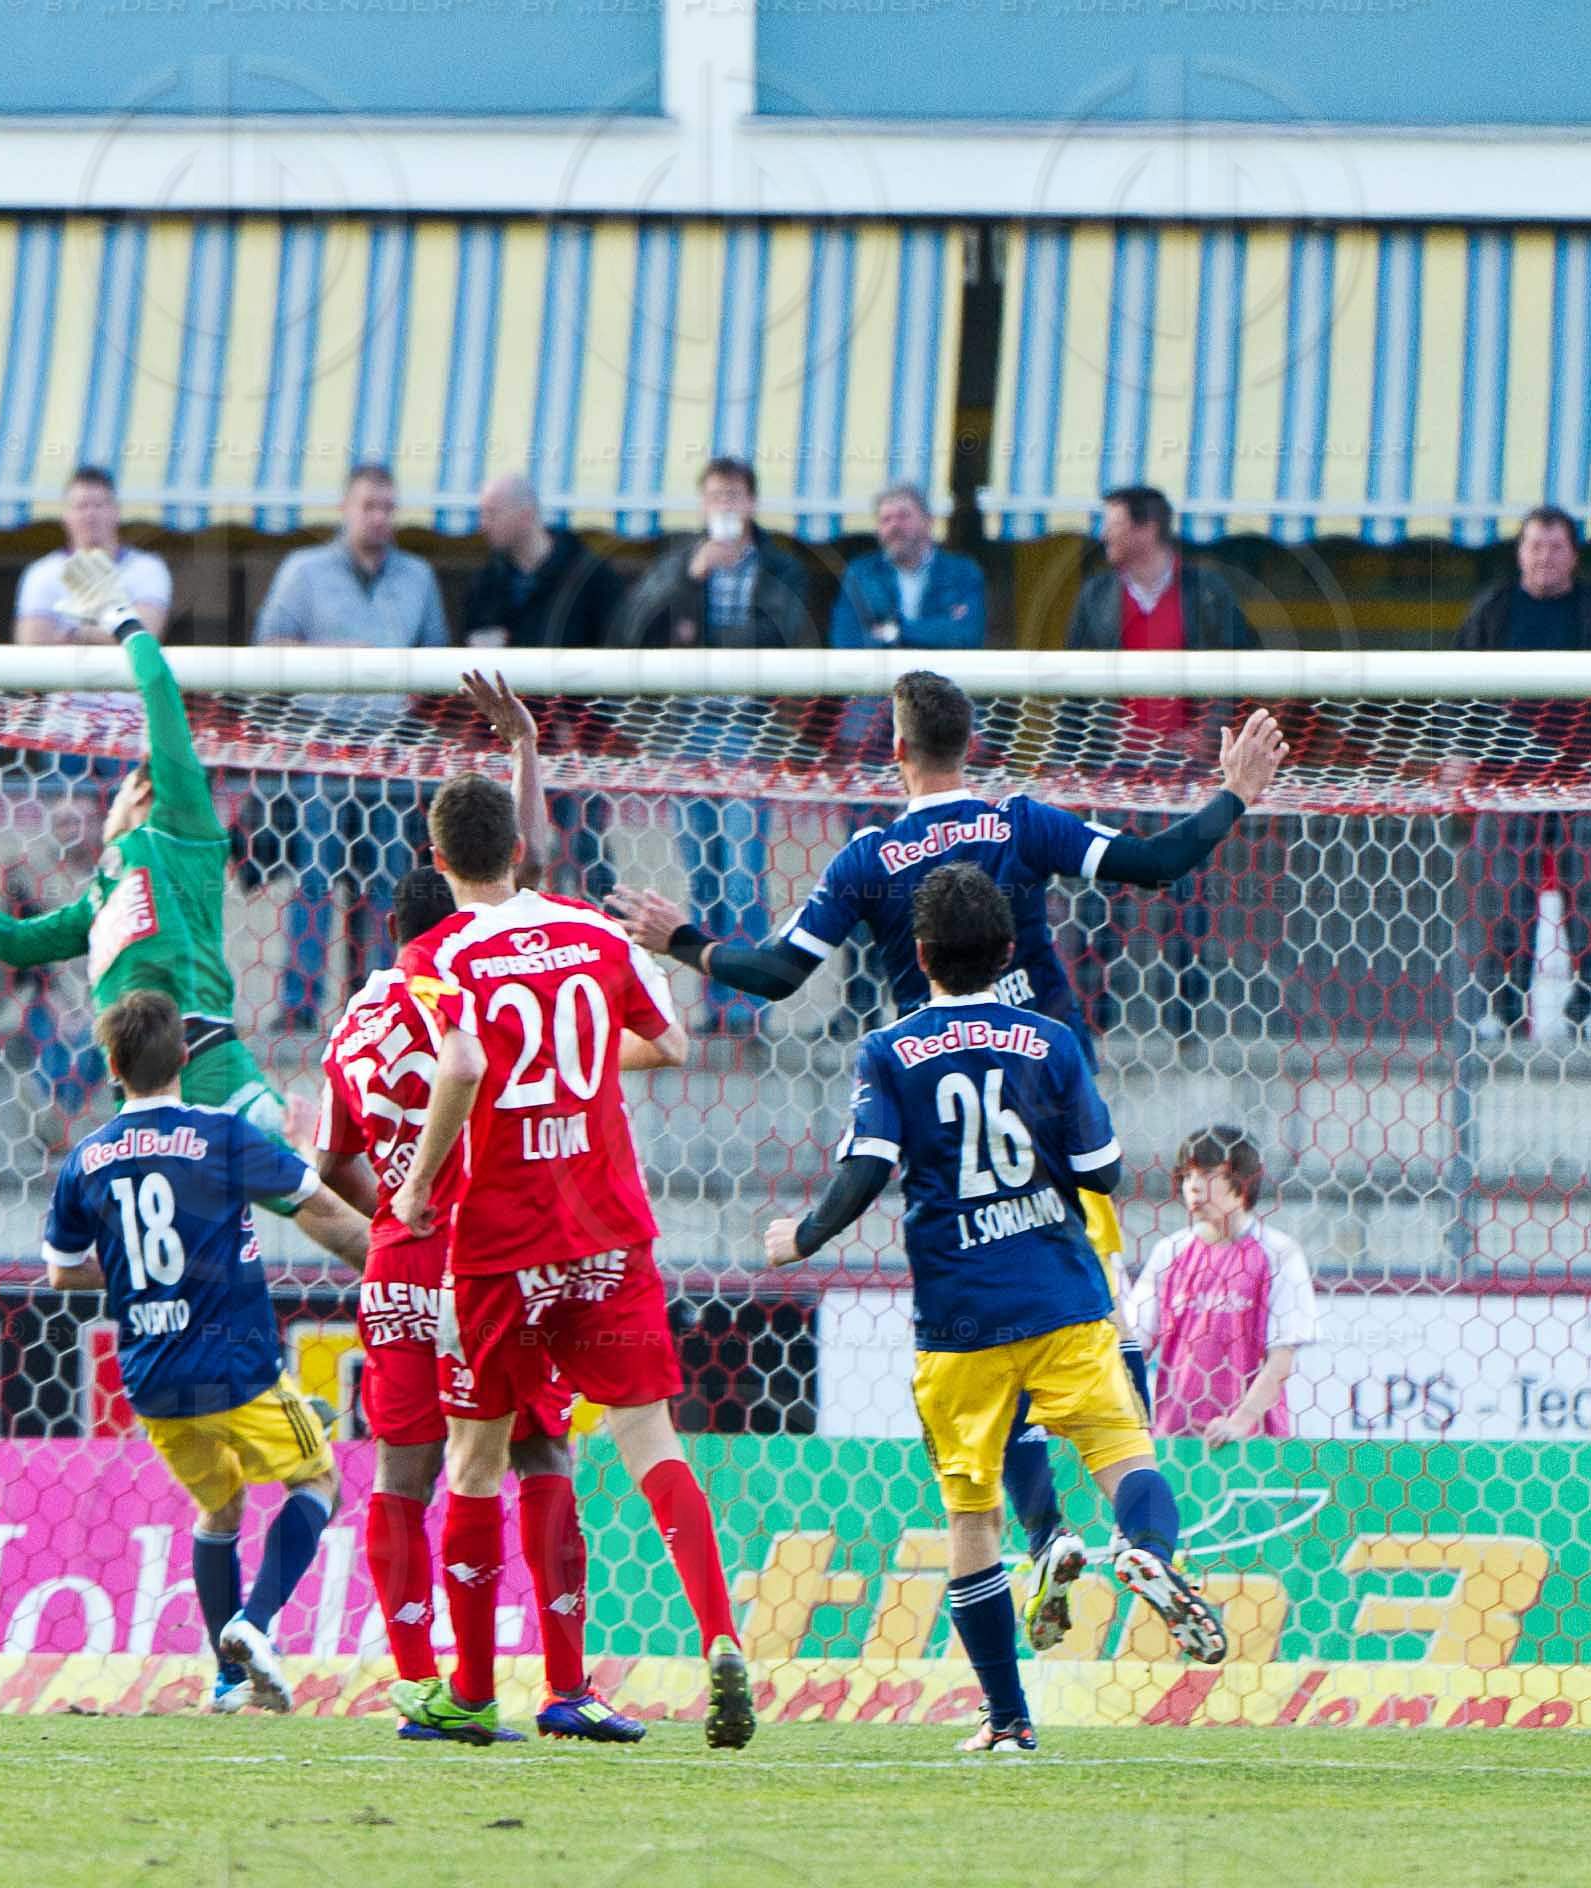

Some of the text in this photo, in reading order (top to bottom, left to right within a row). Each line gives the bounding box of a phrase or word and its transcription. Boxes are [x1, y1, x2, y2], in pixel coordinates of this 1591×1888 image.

[486, 973, 610, 1110] 20
[892, 1021, 1050, 1069] Red Bulls
[936, 1068, 1036, 1200] 26
[110, 1171, 186, 1291] 18
[1350, 1373, 1457, 1431] LPS
